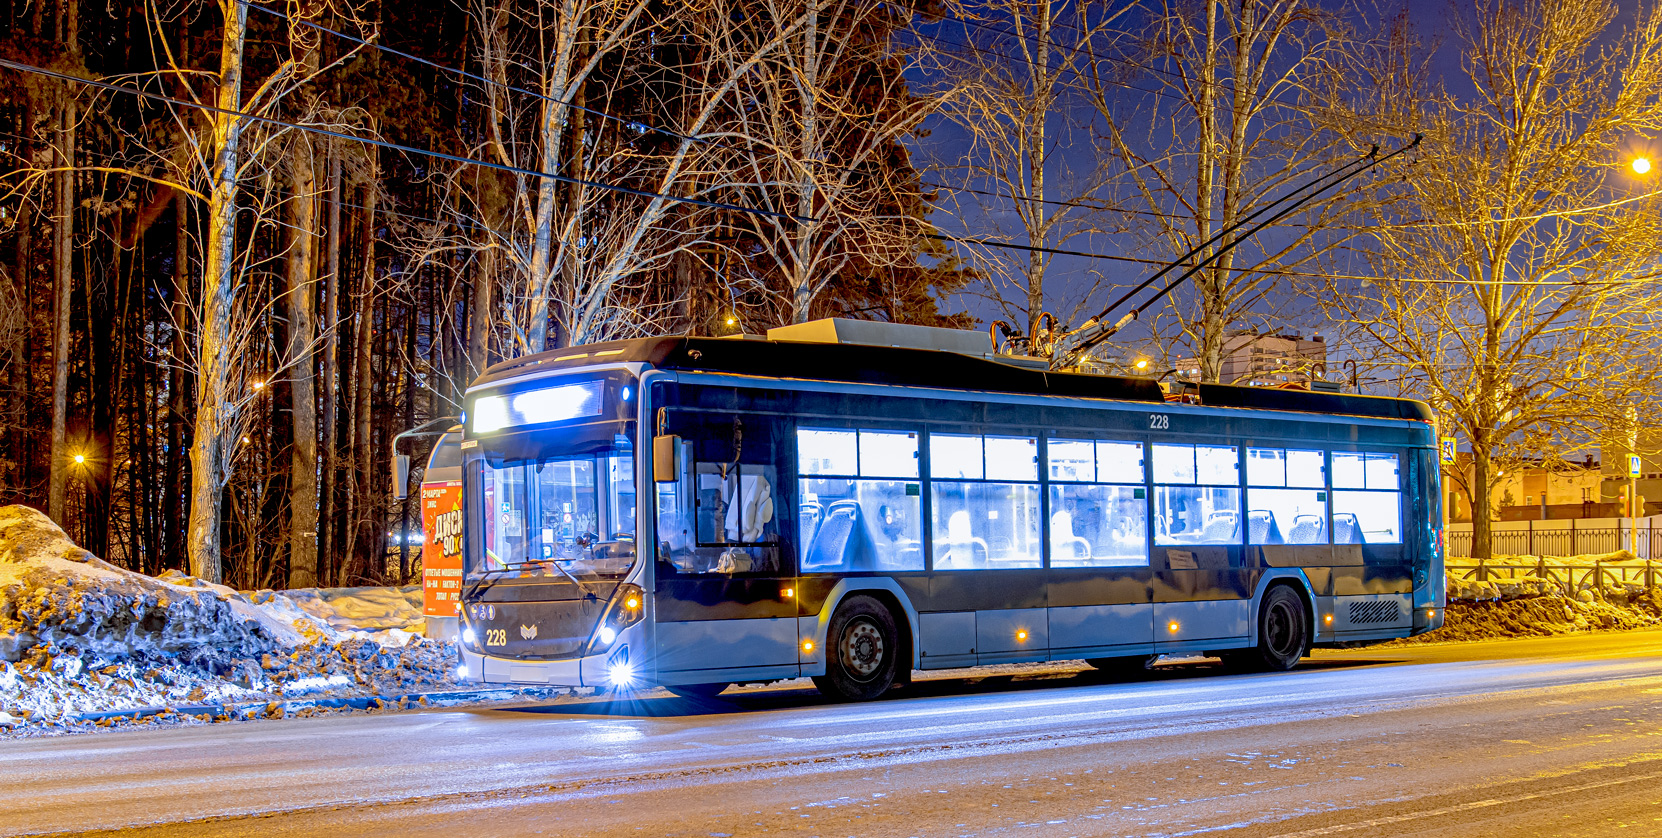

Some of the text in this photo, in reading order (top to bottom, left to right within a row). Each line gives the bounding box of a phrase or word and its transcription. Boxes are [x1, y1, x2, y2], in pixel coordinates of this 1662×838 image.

[1150, 414, 1169, 429] 228
[422, 490, 427, 499] 2
[427, 490, 440, 498] МАРТА
[425, 568, 441, 577] ОТПЕТЫЕ
[486, 629, 507, 647] 228
